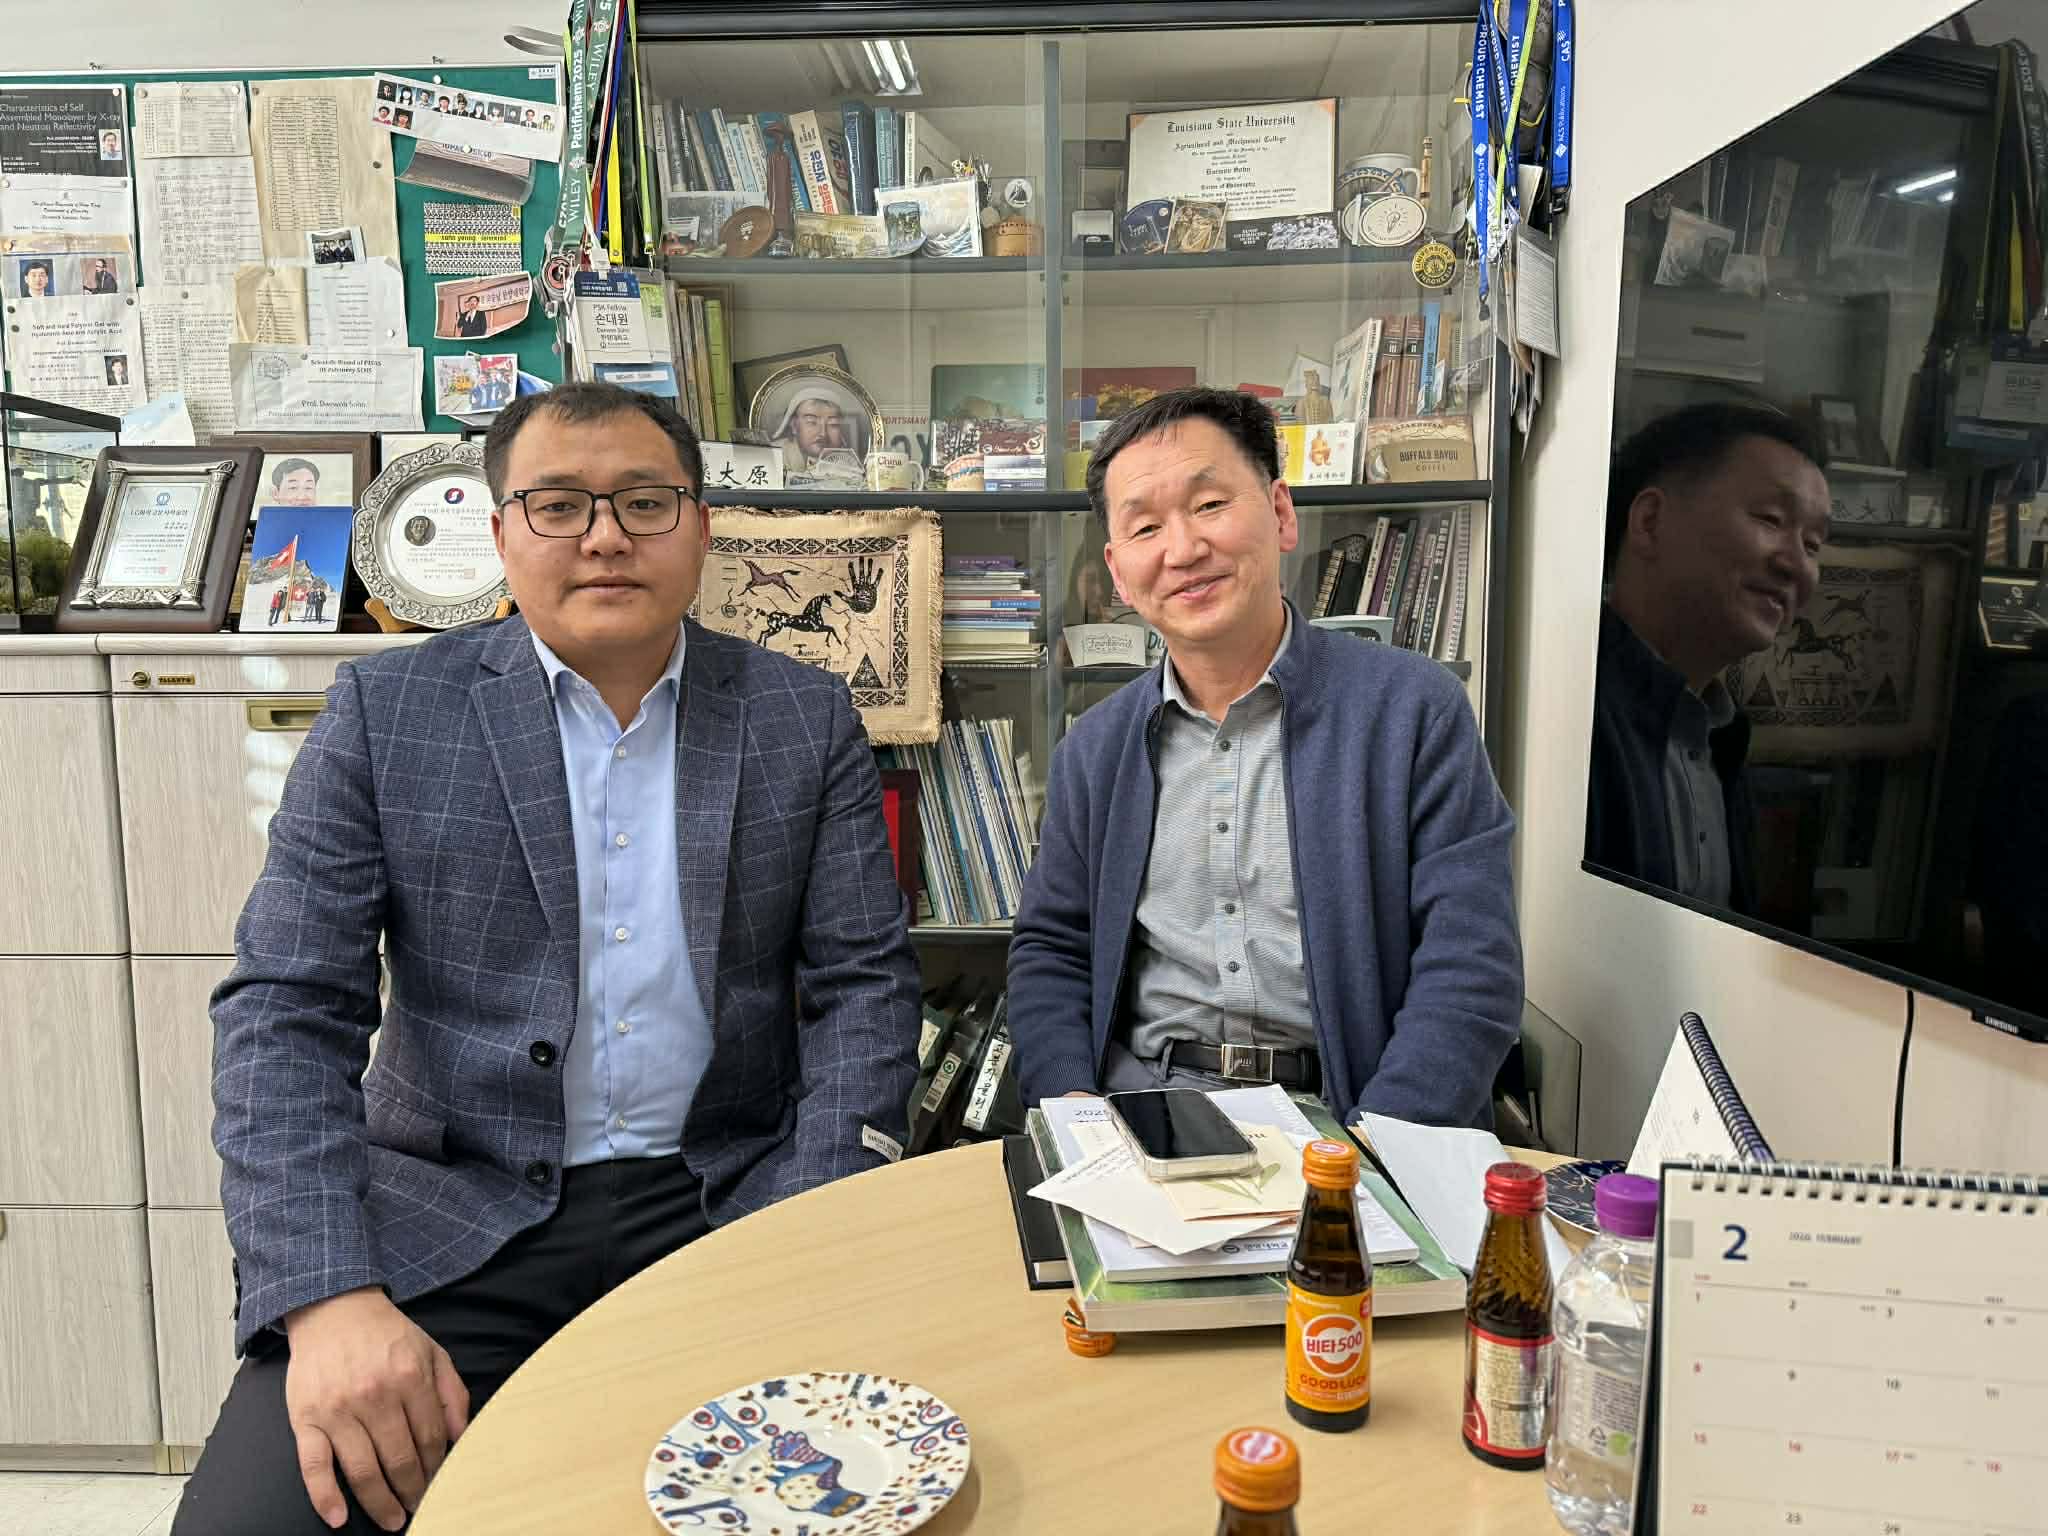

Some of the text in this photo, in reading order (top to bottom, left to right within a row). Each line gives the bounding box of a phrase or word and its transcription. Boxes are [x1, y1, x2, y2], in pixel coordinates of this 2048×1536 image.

[1560, 39, 1571, 62] CAS
[587, 43, 606, 91] WILEY
[1474, 24, 1488, 120] PROUD CHEMIST
[0, 103, 58, 112] Characteristics
[60, 103, 67, 112] of
[571, 49, 584, 149] Pacifichem 2025
[0, 113, 42, 123] Assembled
[87, 113, 97, 123] by
[100, 113, 121, 122] X-ray
[17, 123, 50, 132] Neutron
[54, 123, 97, 132] Reflectivity
[1167, 114, 1296, 133] Louisiana State University
[1263, 136, 1288, 144] College
[567, 177, 582, 222] WILEY
[595, 312, 629, 326] 손대원
[1399, 449, 1459, 463] BUFFALO BAYOU
[1415, 464, 1447, 472] COFFEE
[1984, 1015, 2019, 1034] SAMSUNG
[1722, 1224, 1749, 1261] 2
[1306, 1330, 1363, 1354] 비타500
